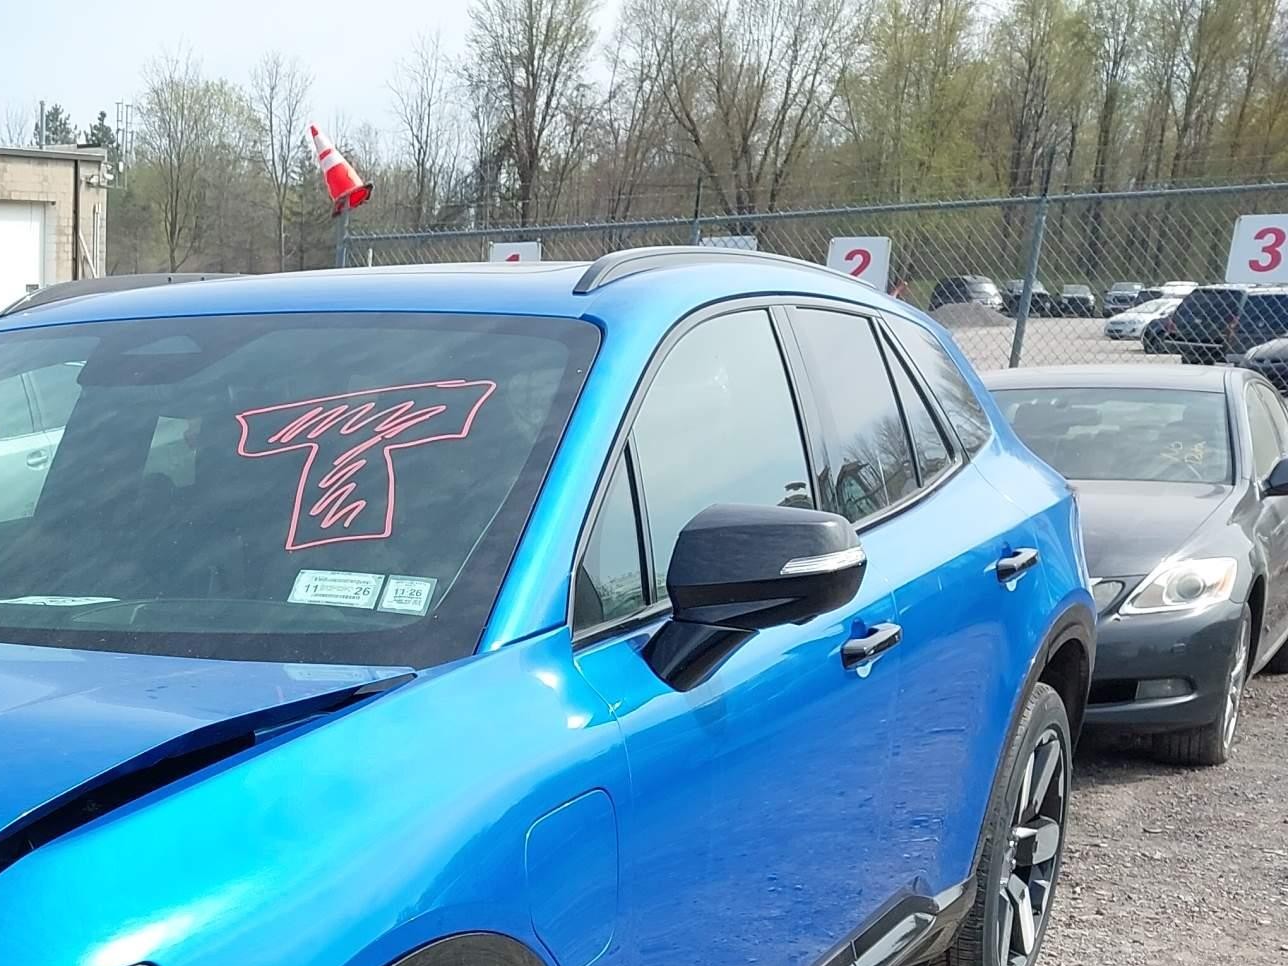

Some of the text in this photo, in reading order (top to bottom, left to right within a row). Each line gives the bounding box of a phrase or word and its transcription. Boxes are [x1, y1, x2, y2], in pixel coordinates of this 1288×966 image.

[844, 249, 871, 277] 2
[1248, 227, 1286, 272] 3
[236, 380, 497, 551] T
[304, 583, 372, 596] 11 26
